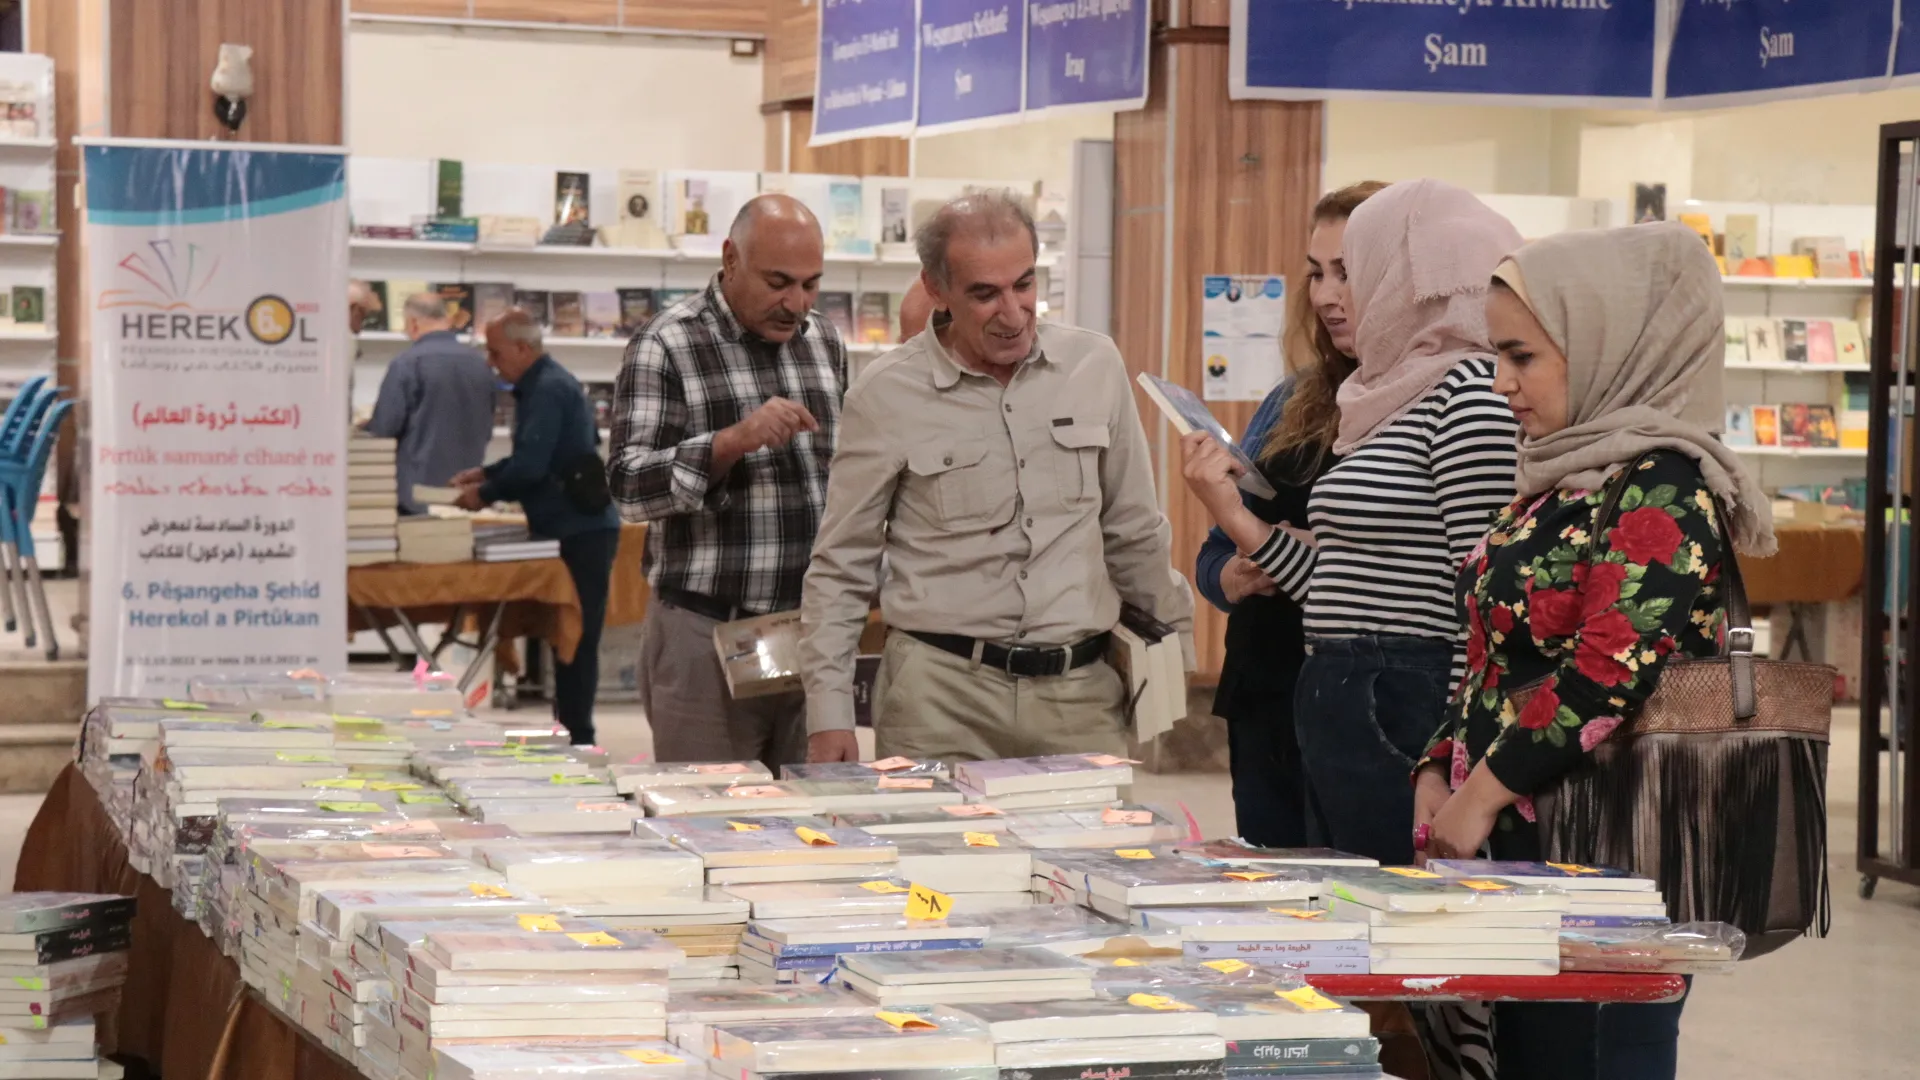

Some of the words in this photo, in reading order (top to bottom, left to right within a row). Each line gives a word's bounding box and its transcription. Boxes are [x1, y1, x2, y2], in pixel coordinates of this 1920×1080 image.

[1424, 32, 1488, 72] Şam
[1759, 26, 1795, 68] Şam
[129, 610, 208, 628] Herekol
[216, 614, 226, 627] a
[1253, 1045, 1282, 1059] جزيرة
[1284, 1044, 1310, 1058] الكنز
